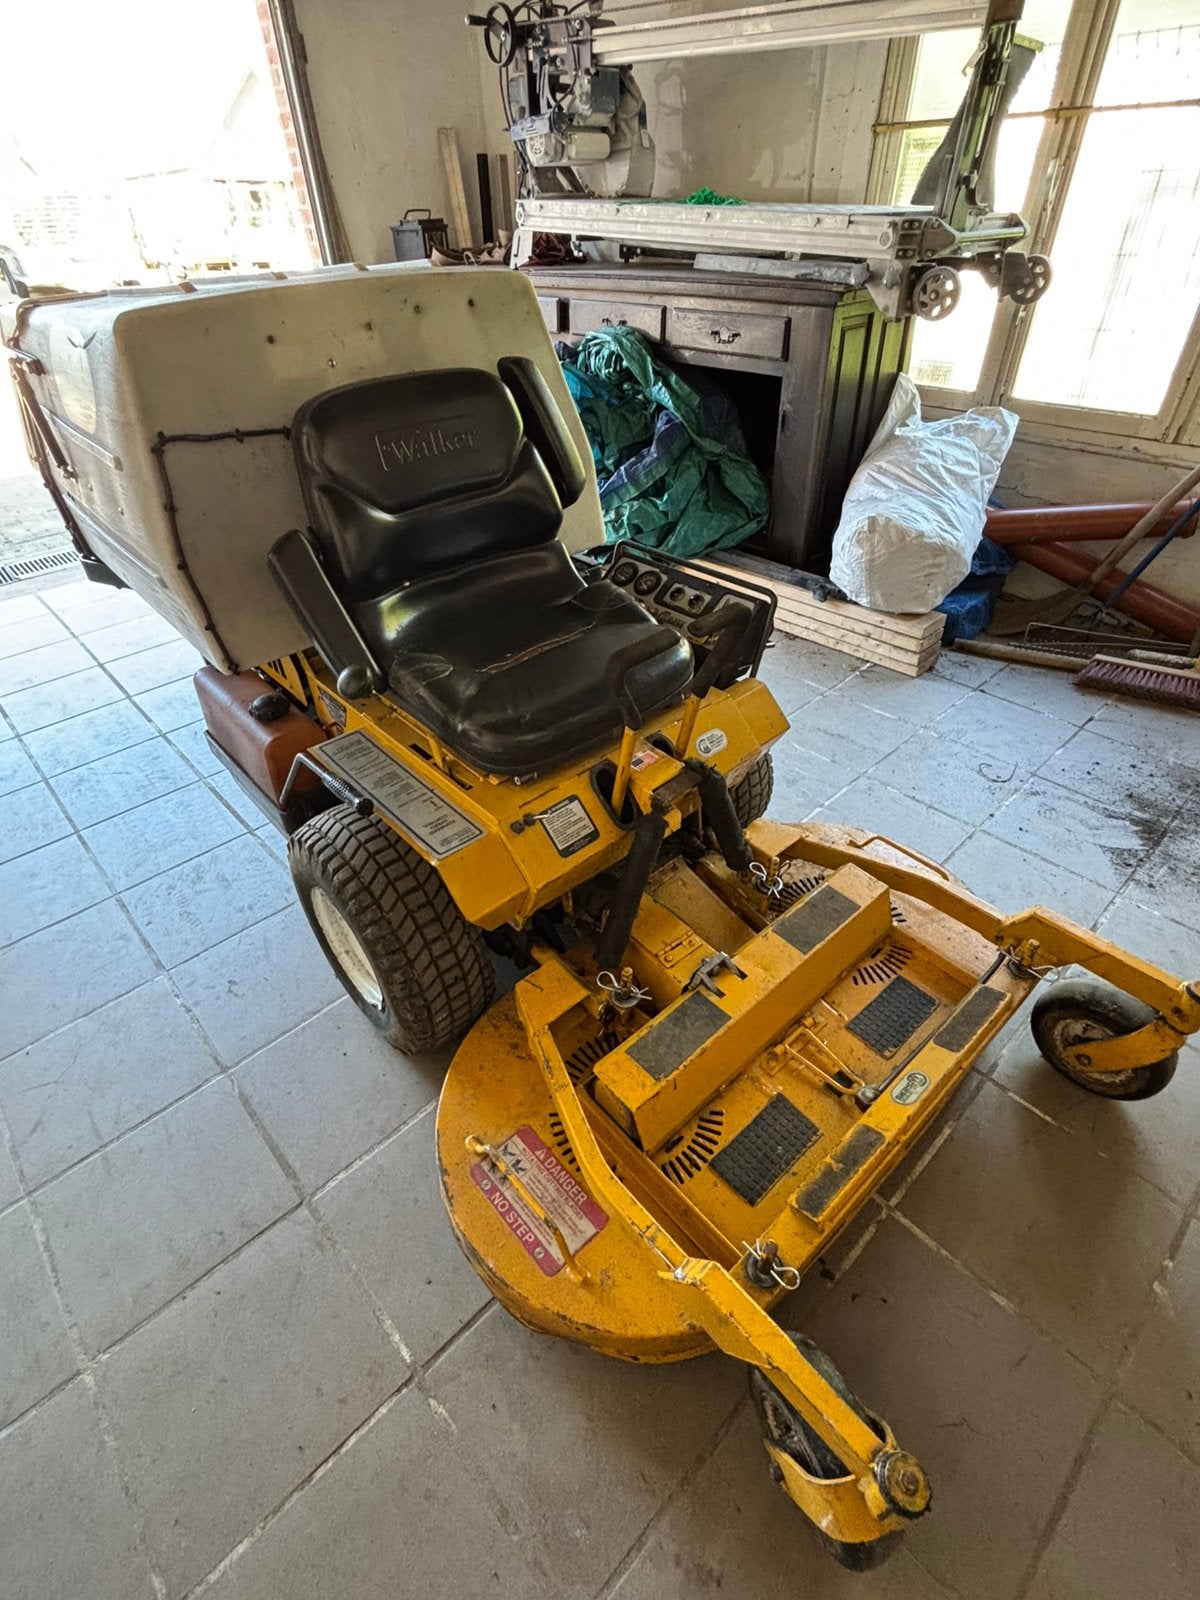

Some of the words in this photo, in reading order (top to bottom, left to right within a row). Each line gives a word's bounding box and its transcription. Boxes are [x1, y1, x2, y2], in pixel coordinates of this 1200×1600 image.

[543, 1156, 588, 1205] DANGER
[490, 1192, 509, 1213] NO
[505, 1211, 535, 1242] STEP
